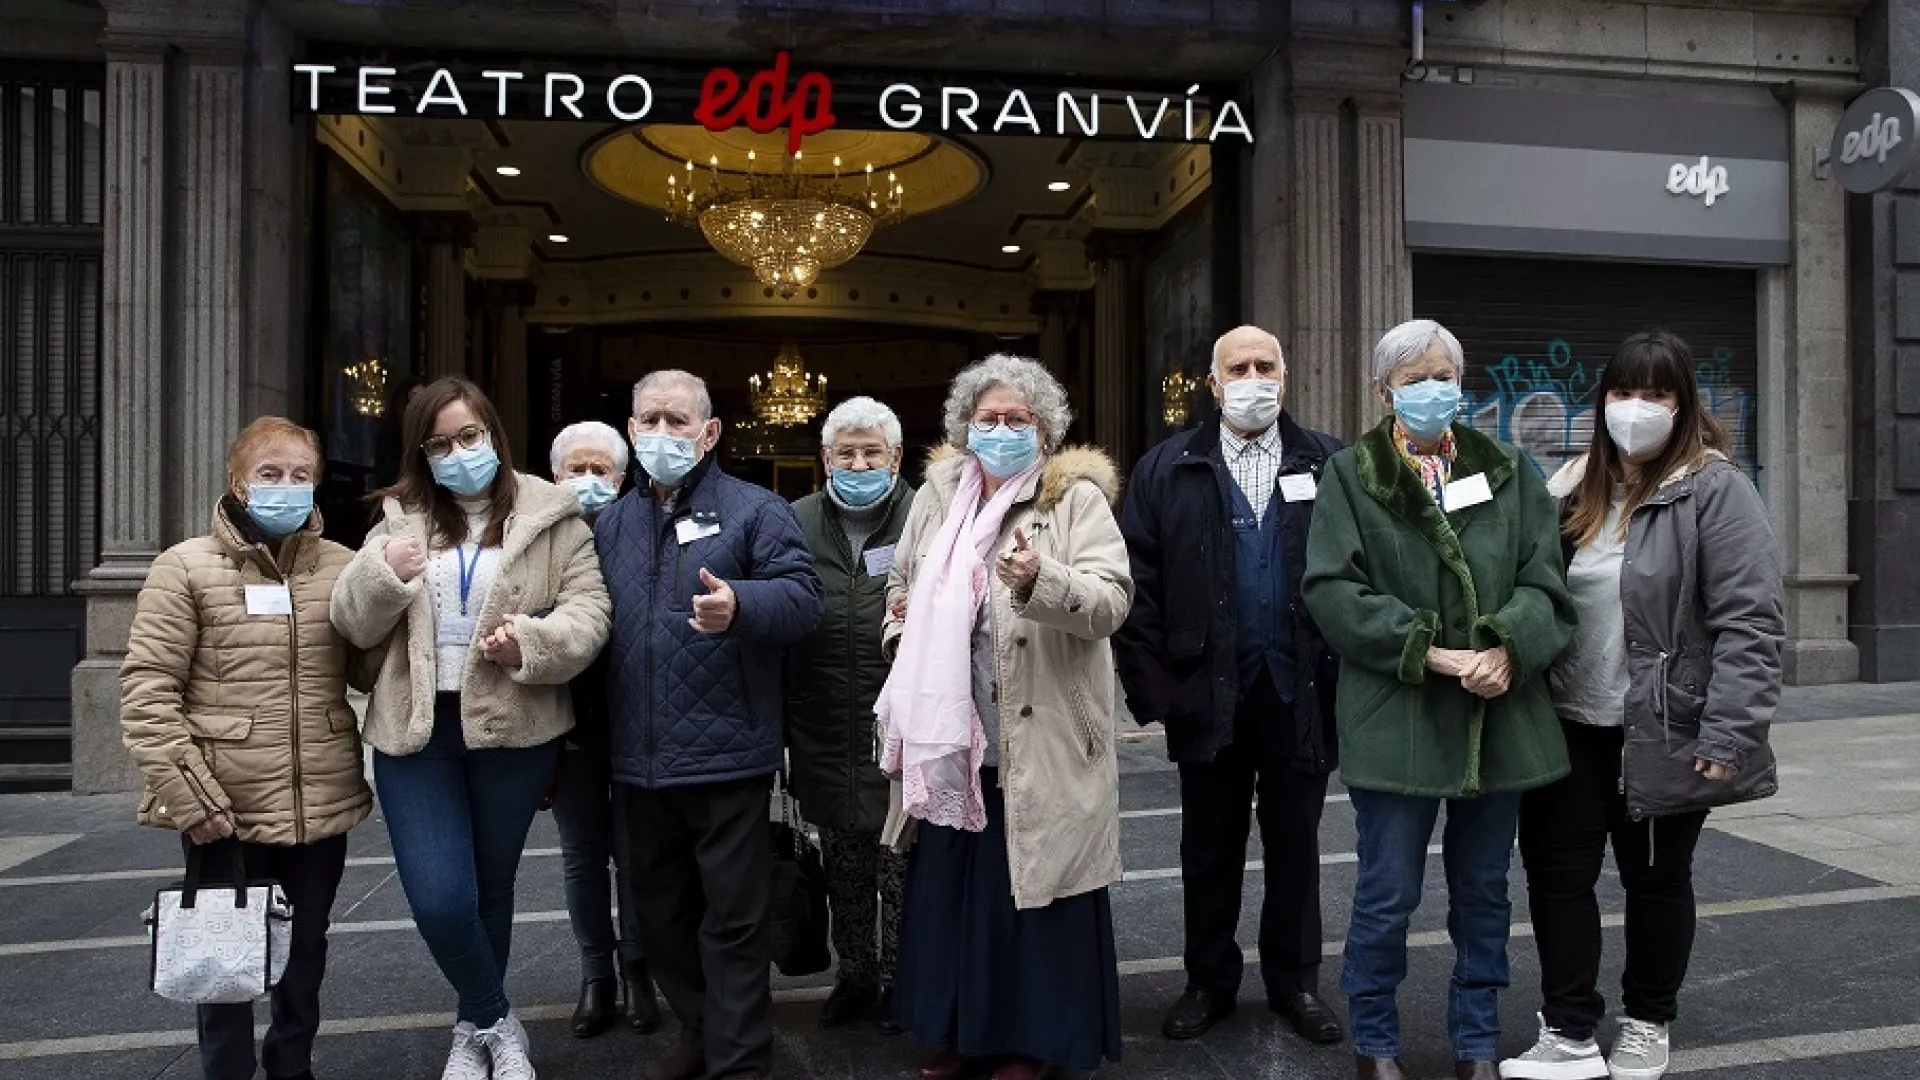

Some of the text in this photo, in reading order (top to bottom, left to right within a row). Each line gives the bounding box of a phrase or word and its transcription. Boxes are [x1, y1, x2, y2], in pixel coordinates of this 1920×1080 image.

[293, 52, 1255, 154] TEATRO edp GRAN VÍA
[1839, 112, 1902, 164] edp
[1664, 156, 1730, 208] edp
